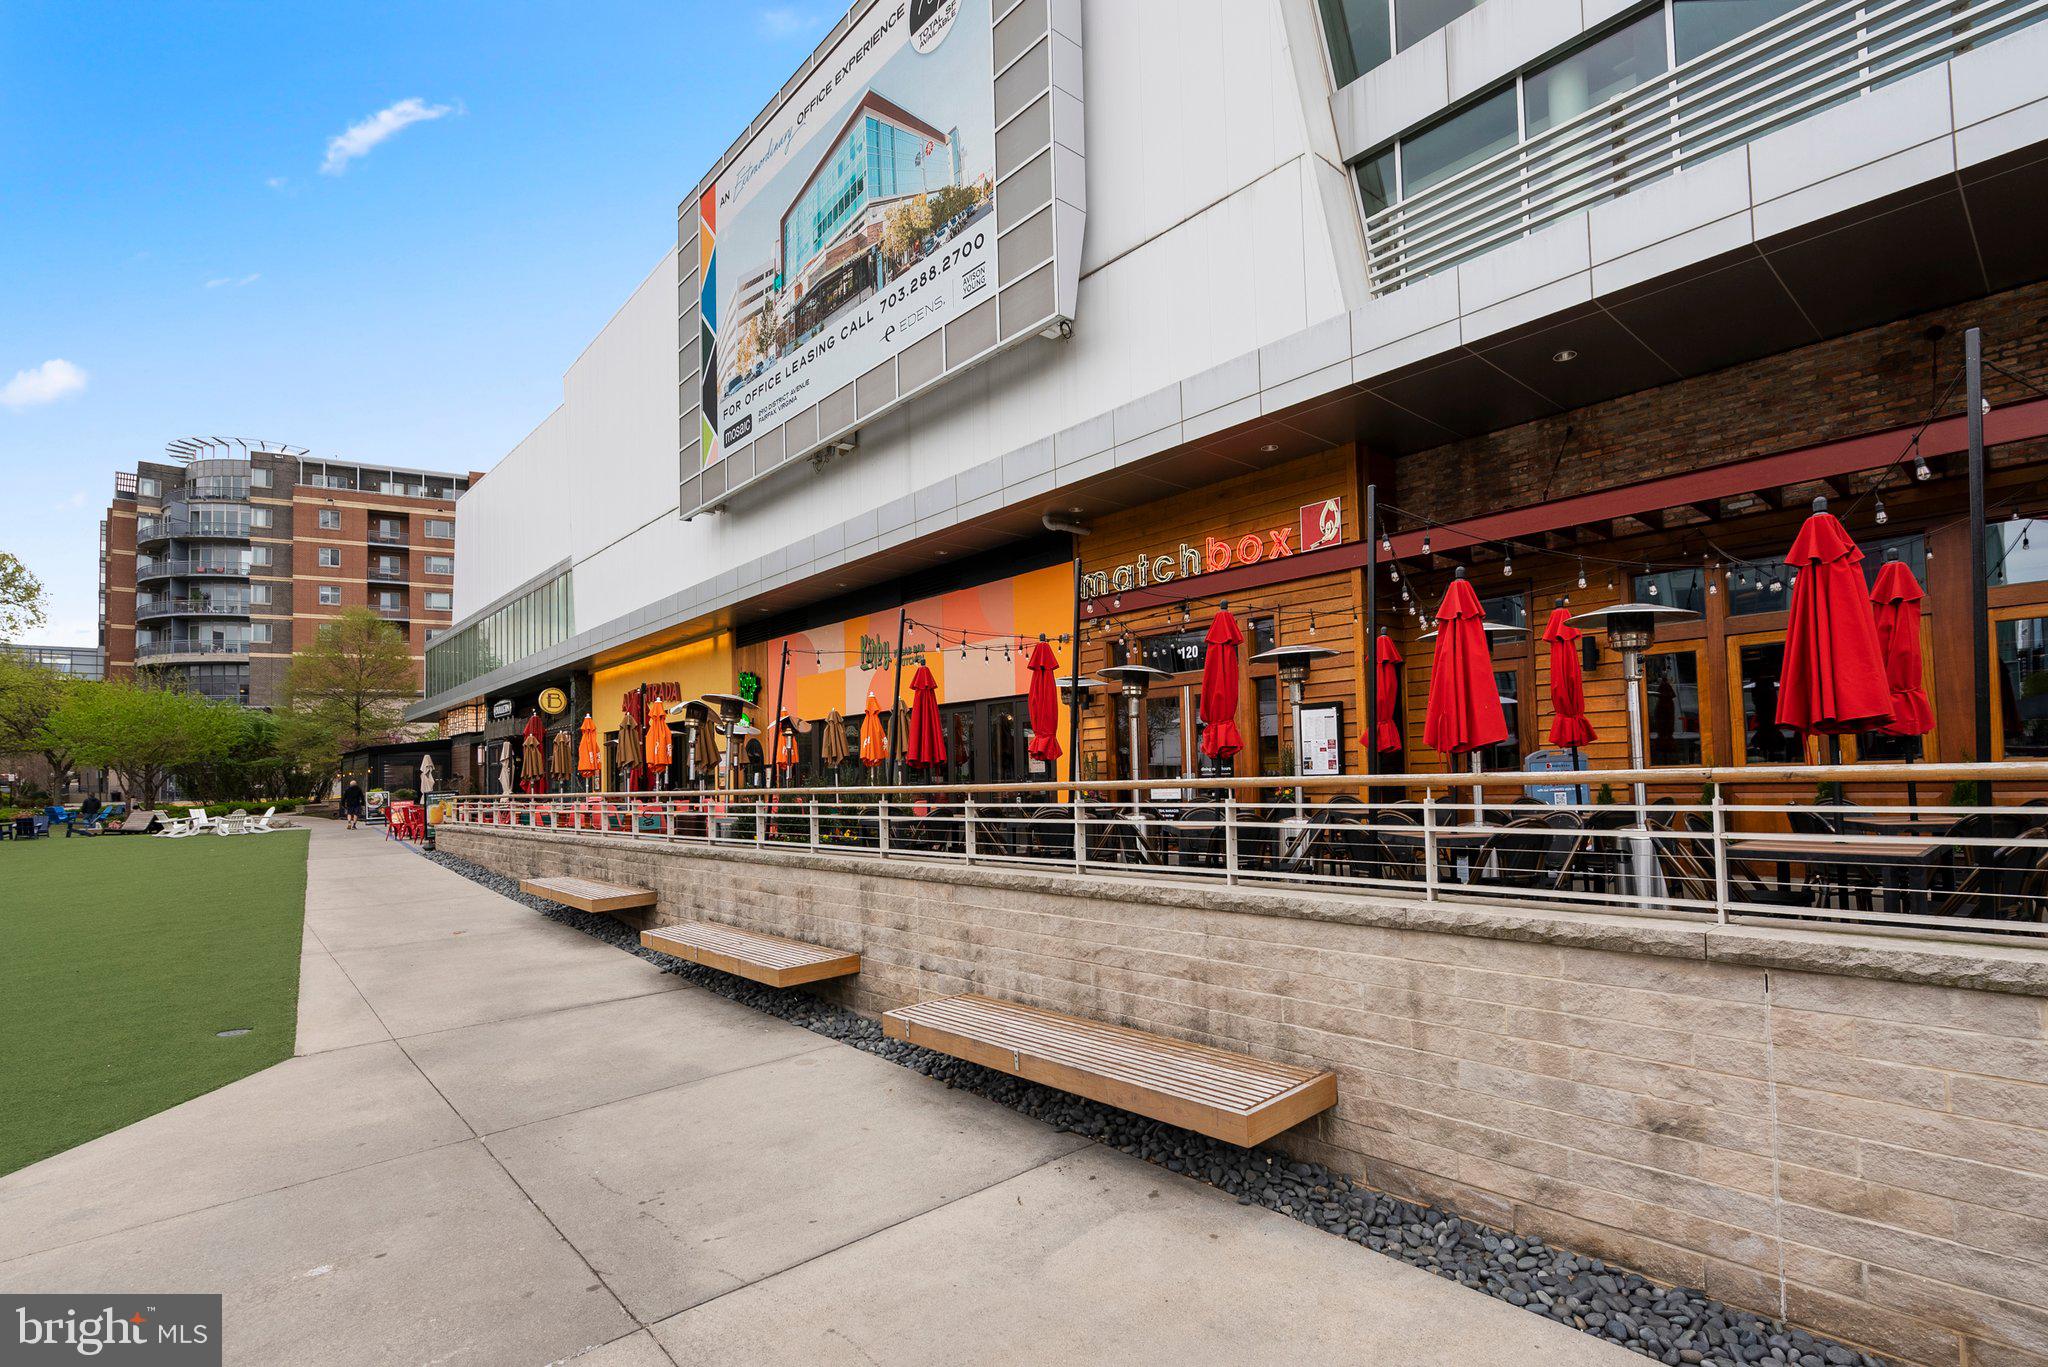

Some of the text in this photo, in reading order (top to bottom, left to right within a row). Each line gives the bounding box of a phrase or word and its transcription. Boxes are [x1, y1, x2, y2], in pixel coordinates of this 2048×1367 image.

[918, 15, 943, 41] TOTAL
[945, 0, 957, 15] SF
[919, 8, 957, 50] AVAILABLE
[719, 3, 905, 208] AN Extraordinary OFFICE EXPERIENCE
[963, 266, 986, 286] AVISON
[963, 276, 986, 295] YOUNG
[723, 232, 985, 420] FOR OFFICE LEASING CALL 703.288.2700
[725, 419, 751, 444] mosaic
[860, 633, 892, 671] Kirby
[1181, 645, 1199, 659] 120
[547, 692, 563, 709] B
